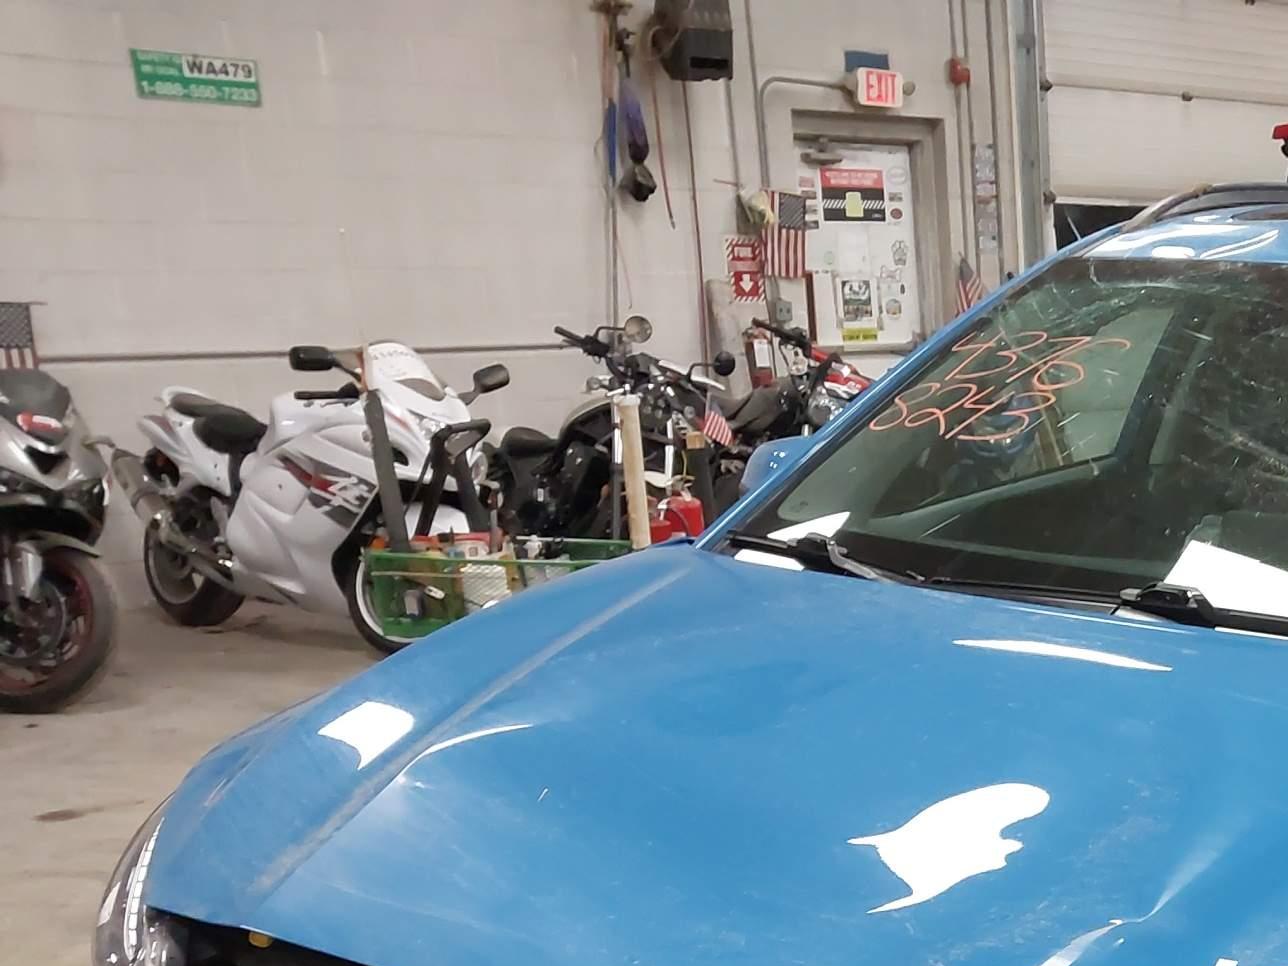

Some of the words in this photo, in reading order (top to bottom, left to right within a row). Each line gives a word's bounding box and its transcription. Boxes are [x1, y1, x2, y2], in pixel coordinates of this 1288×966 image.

[186, 59, 253, 79] WA479
[866, 71, 896, 104] EXIT
[944, 330, 1131, 390] 4376
[868, 382, 1057, 440] 8243
